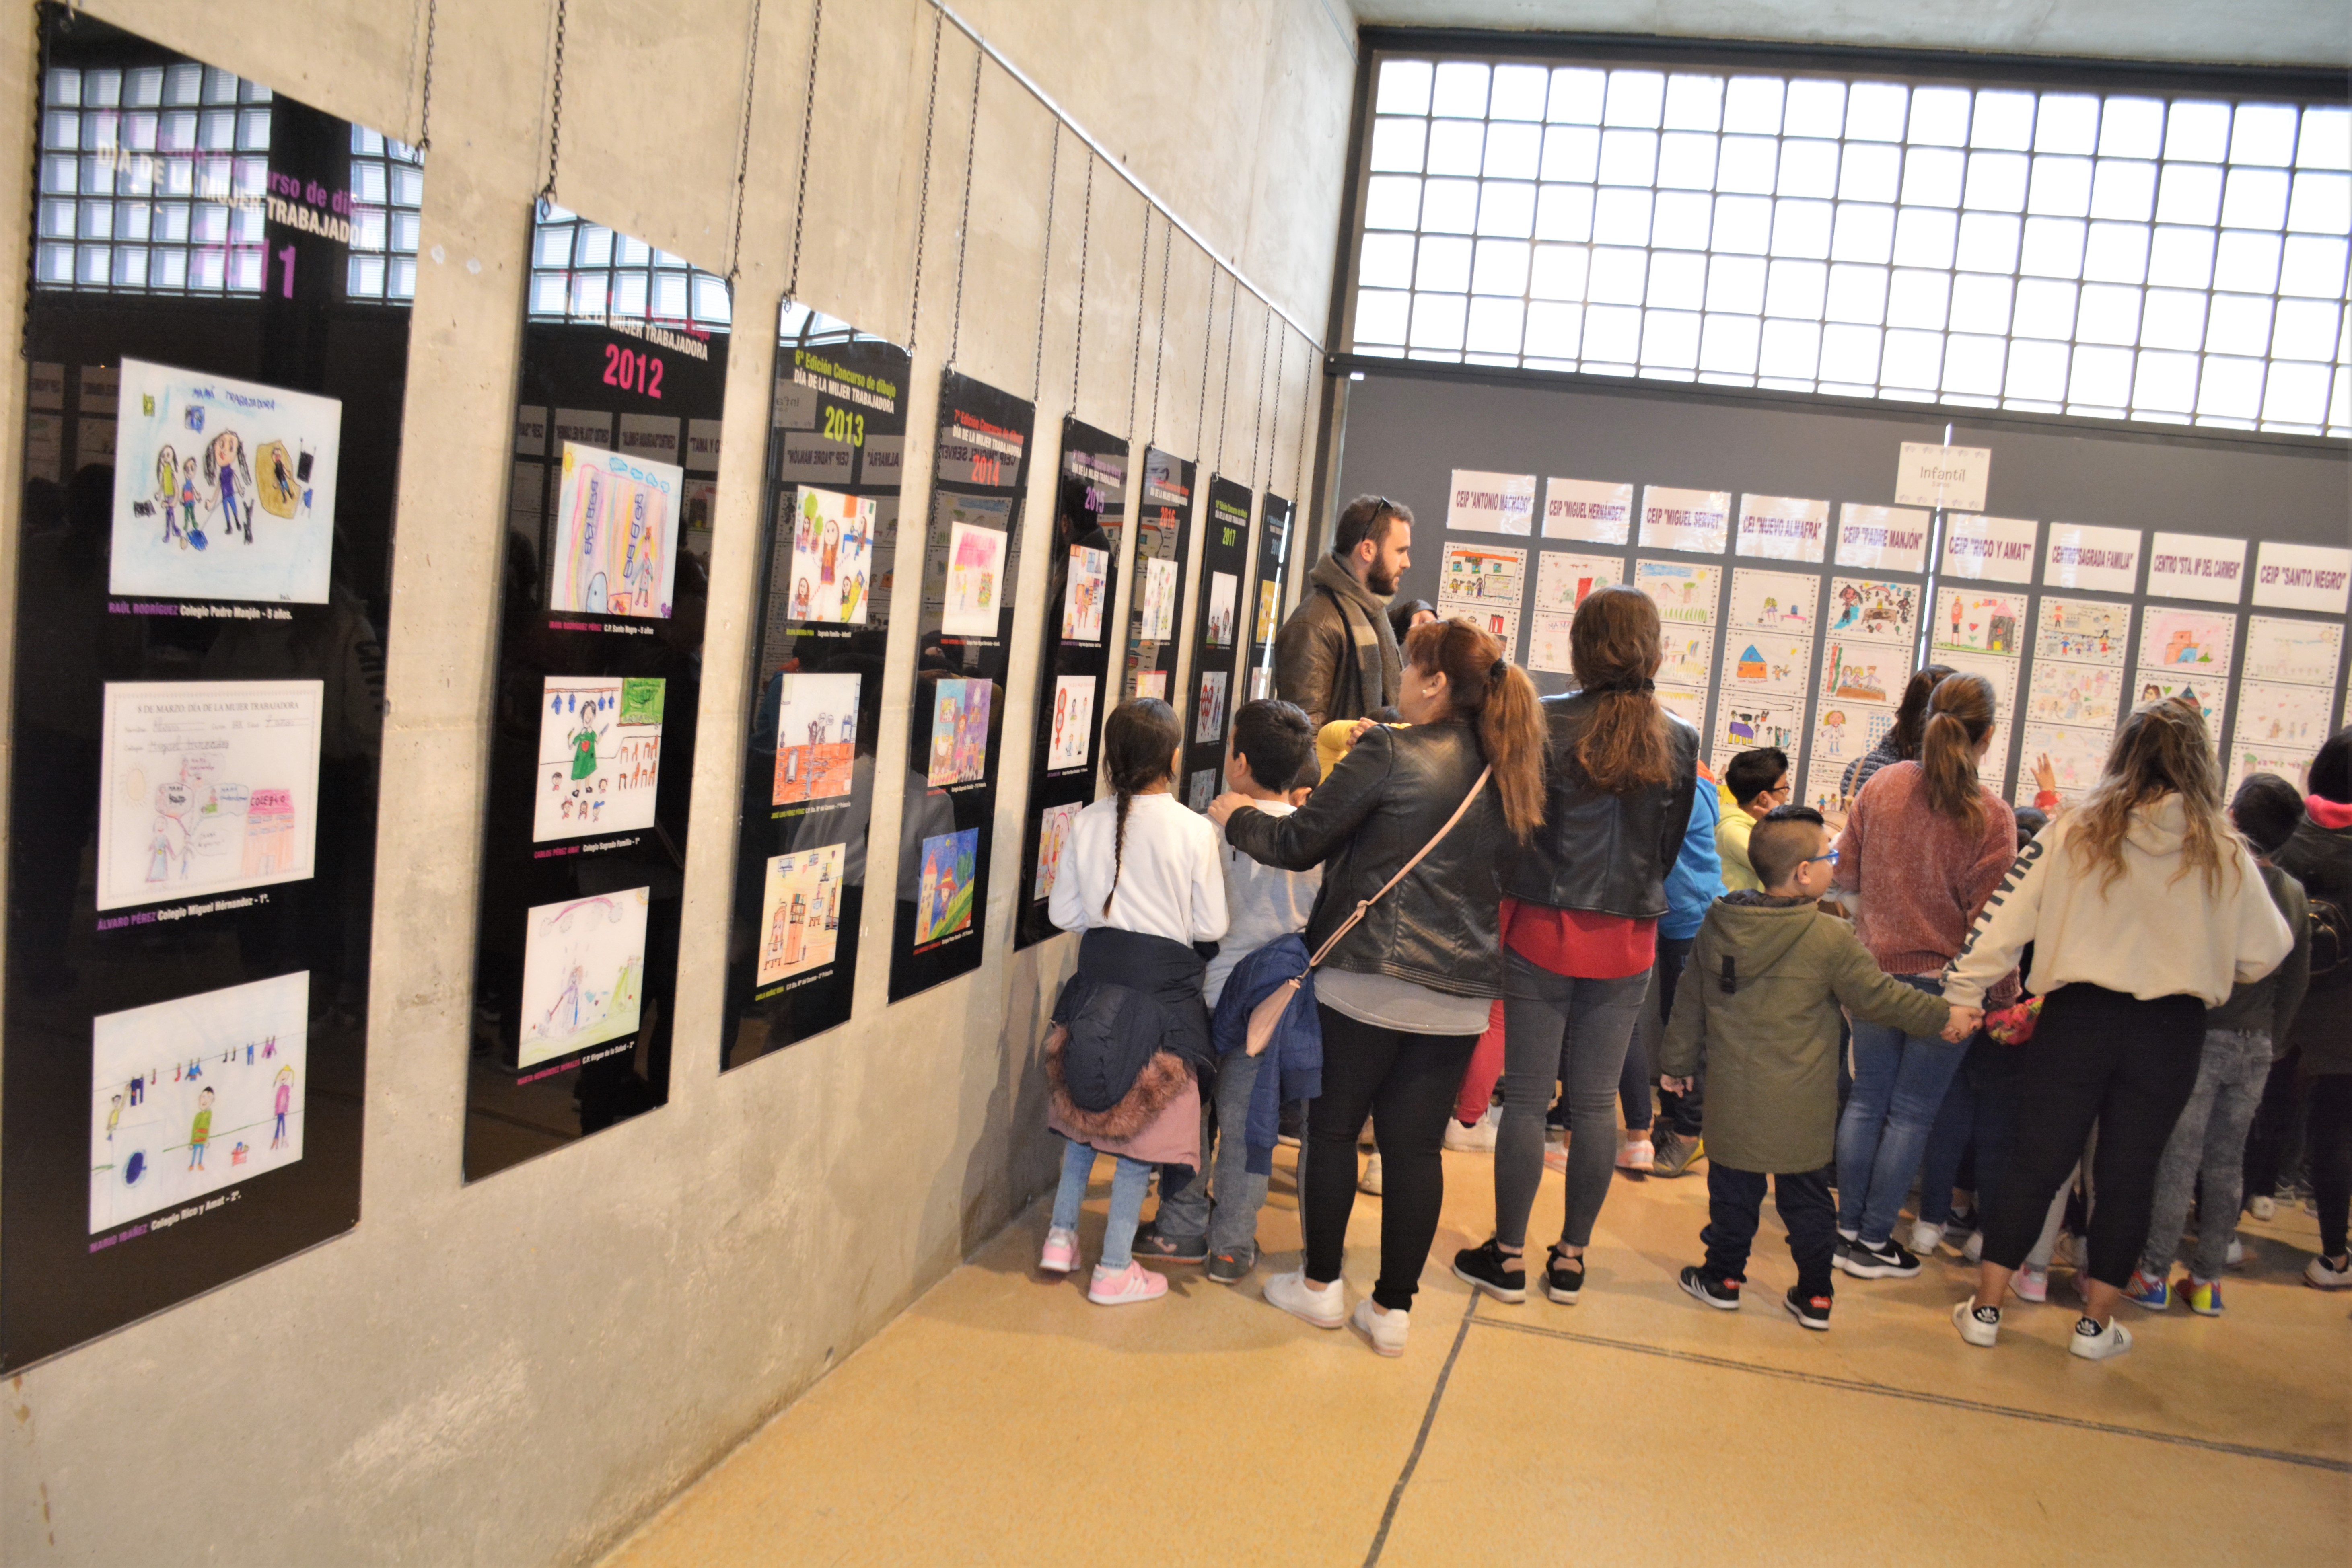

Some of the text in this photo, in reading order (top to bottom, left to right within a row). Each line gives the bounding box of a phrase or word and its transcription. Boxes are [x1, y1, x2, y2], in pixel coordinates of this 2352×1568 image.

[306, 180, 327, 208] de
[646, 323, 708, 361] TRABAJADORA
[603, 343, 663, 399] 2012
[795, 349, 897, 400] 6ª Edición Concurso de dibujo
[794, 367, 895, 415] DÍA DE LA MUJER TRABAJADORA
[823, 405, 864, 447] 2013
[962, 427, 968, 441] DE
[969, 431, 975, 444] LA
[971, 453, 1001, 487] 2014
[1920, 466, 1966, 483] Infantil
[1085, 485, 1105, 514] 2015
[1456, 491, 1531, 514] CEIP "ANTONIO MACHADO"
[1549, 499, 1625, 522] CEIP "MIGUEL HERNÁNDEZ"
[1646, 508, 1724, 530] CEIP "MIGUEL SERVET"
[1743, 515, 1822, 540] CEI "NUEVO ALMAFRÁ"
[1843, 526, 1923, 551] CEIP "PADRE MANJÓN"
[1949, 536, 2032, 561] CEIP "RICO Y AMAT"
[2154, 555, 2177, 574] CENTRO
[2201, 558, 2212, 577] DEL
[2214, 560, 2241, 580] CARMEN"
[2260, 565, 2346, 590] CEIP "SANTO NEGRO"
[179, 603, 209, 619] Colegio
[157, 907, 187, 921] Colegio
[187, 902, 214, 917] Miguel
